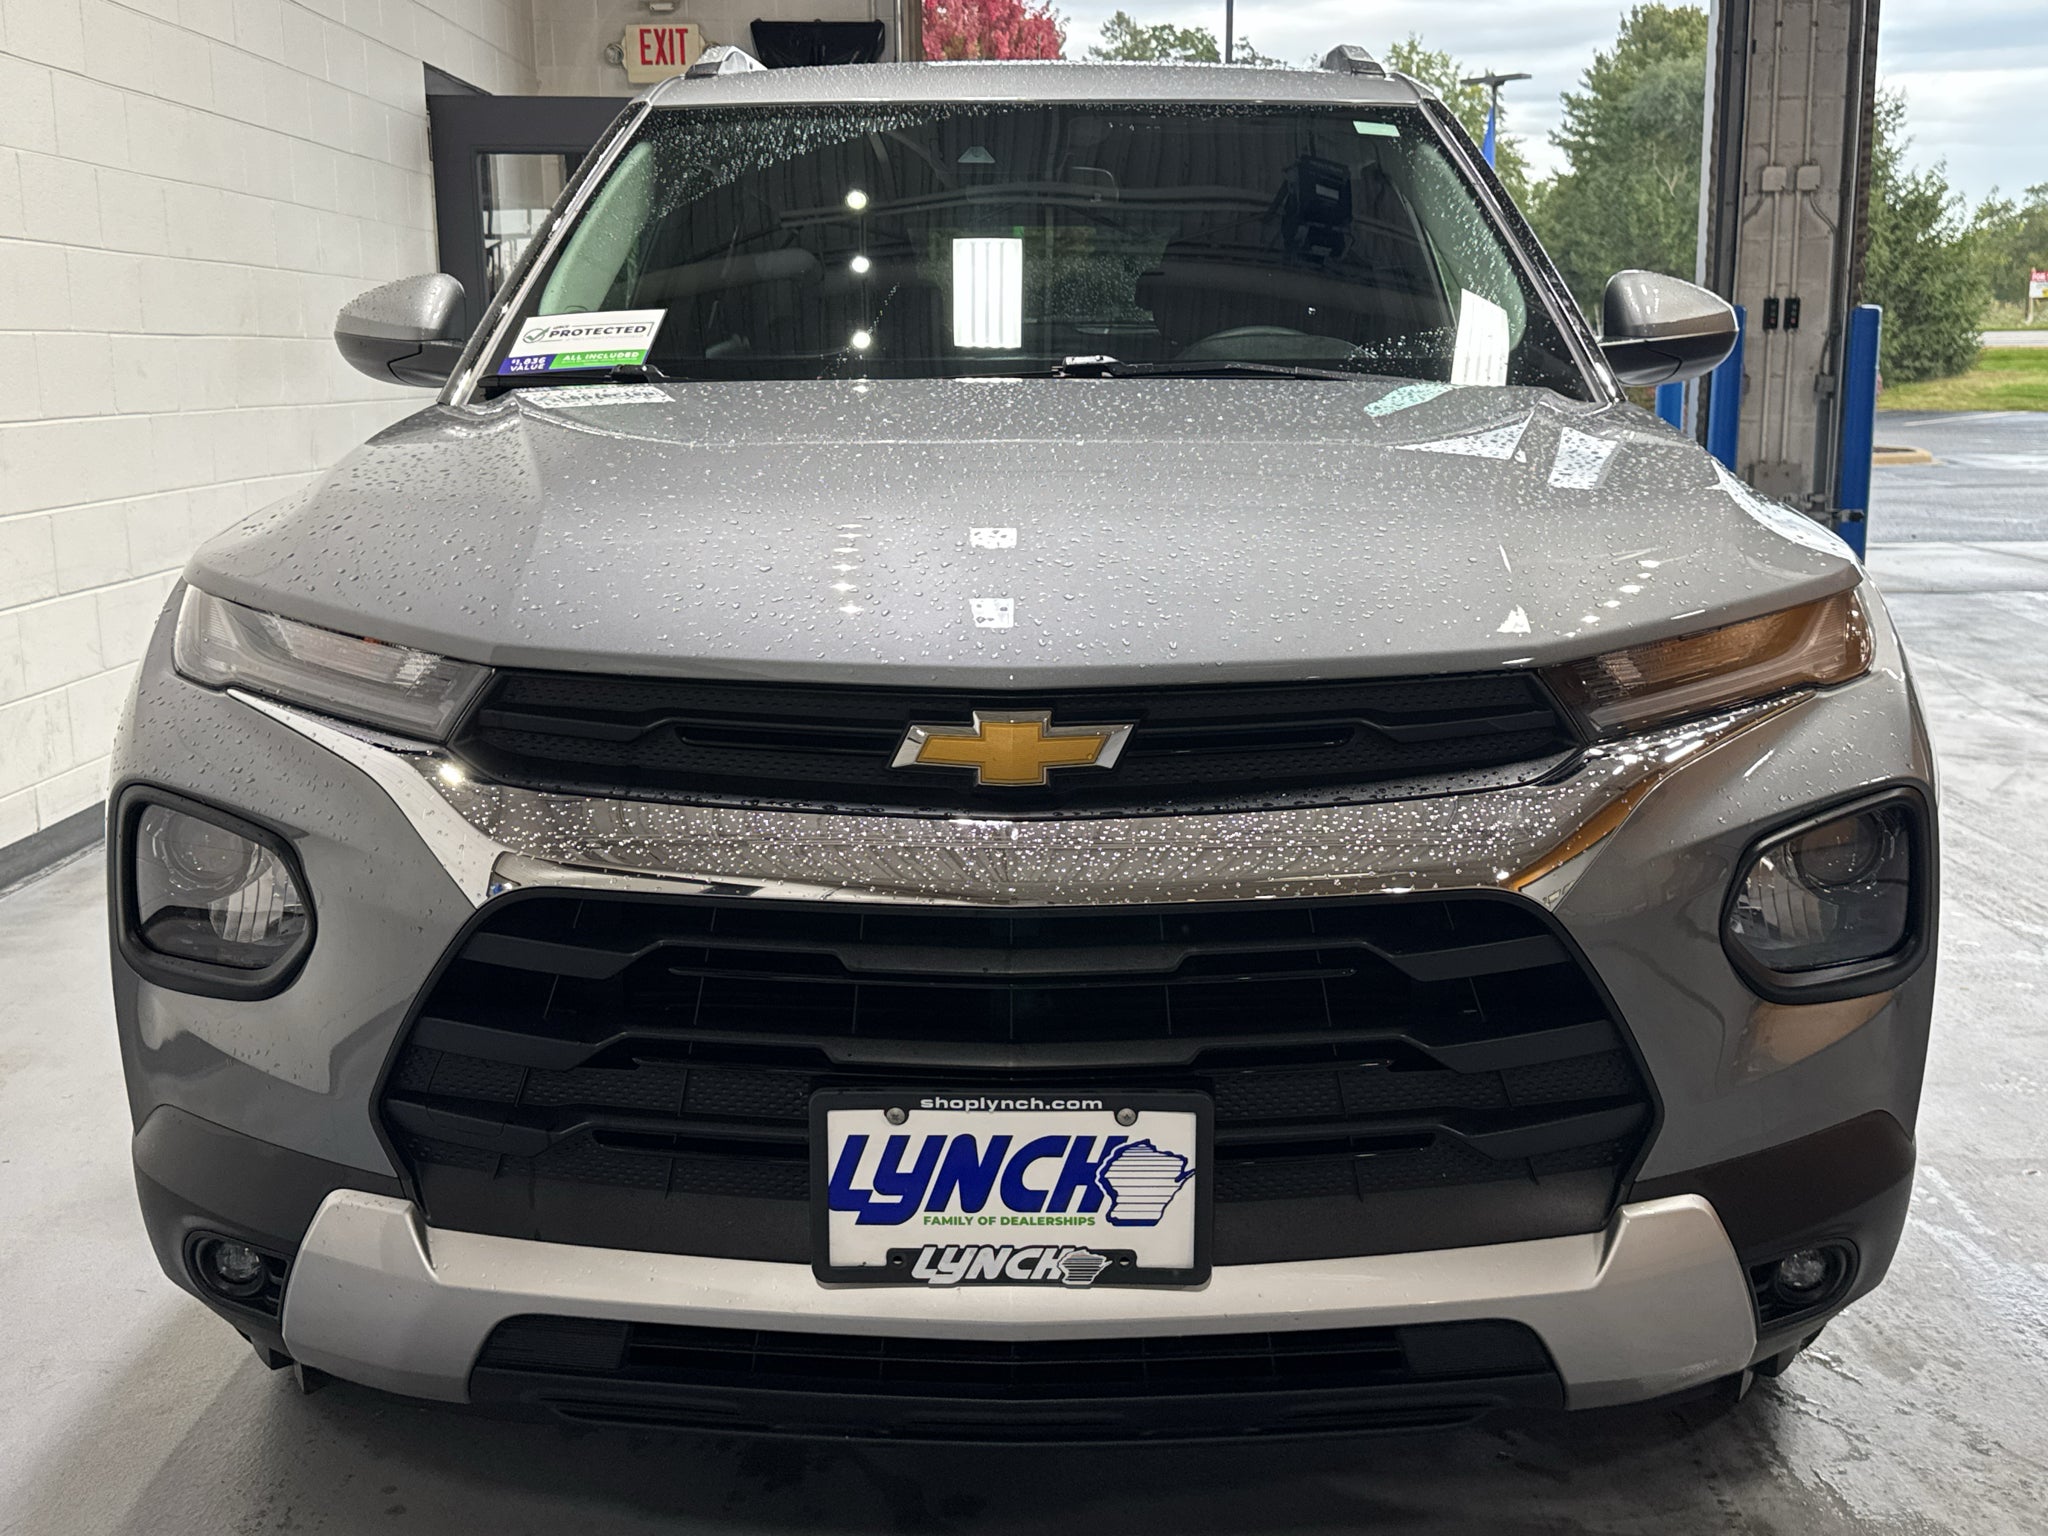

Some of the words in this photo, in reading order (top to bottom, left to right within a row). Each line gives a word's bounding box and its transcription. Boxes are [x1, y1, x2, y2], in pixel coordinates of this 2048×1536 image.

[639, 28, 689, 66] EXIT
[549, 325, 647, 338] PROTECTED
[585, 351, 640, 361] INCLUDED
[510, 363, 546, 371] VALUE
[920, 1096, 1103, 1113] shoplynch.com
[829, 1133, 1129, 1226] LYNCH
[923, 1216, 974, 1226] FAMILY
[978, 1216, 997, 1226] OF
[1000, 1216, 1096, 1226] DEALERSHIPS
[911, 1245, 1076, 1284] LYNCH
